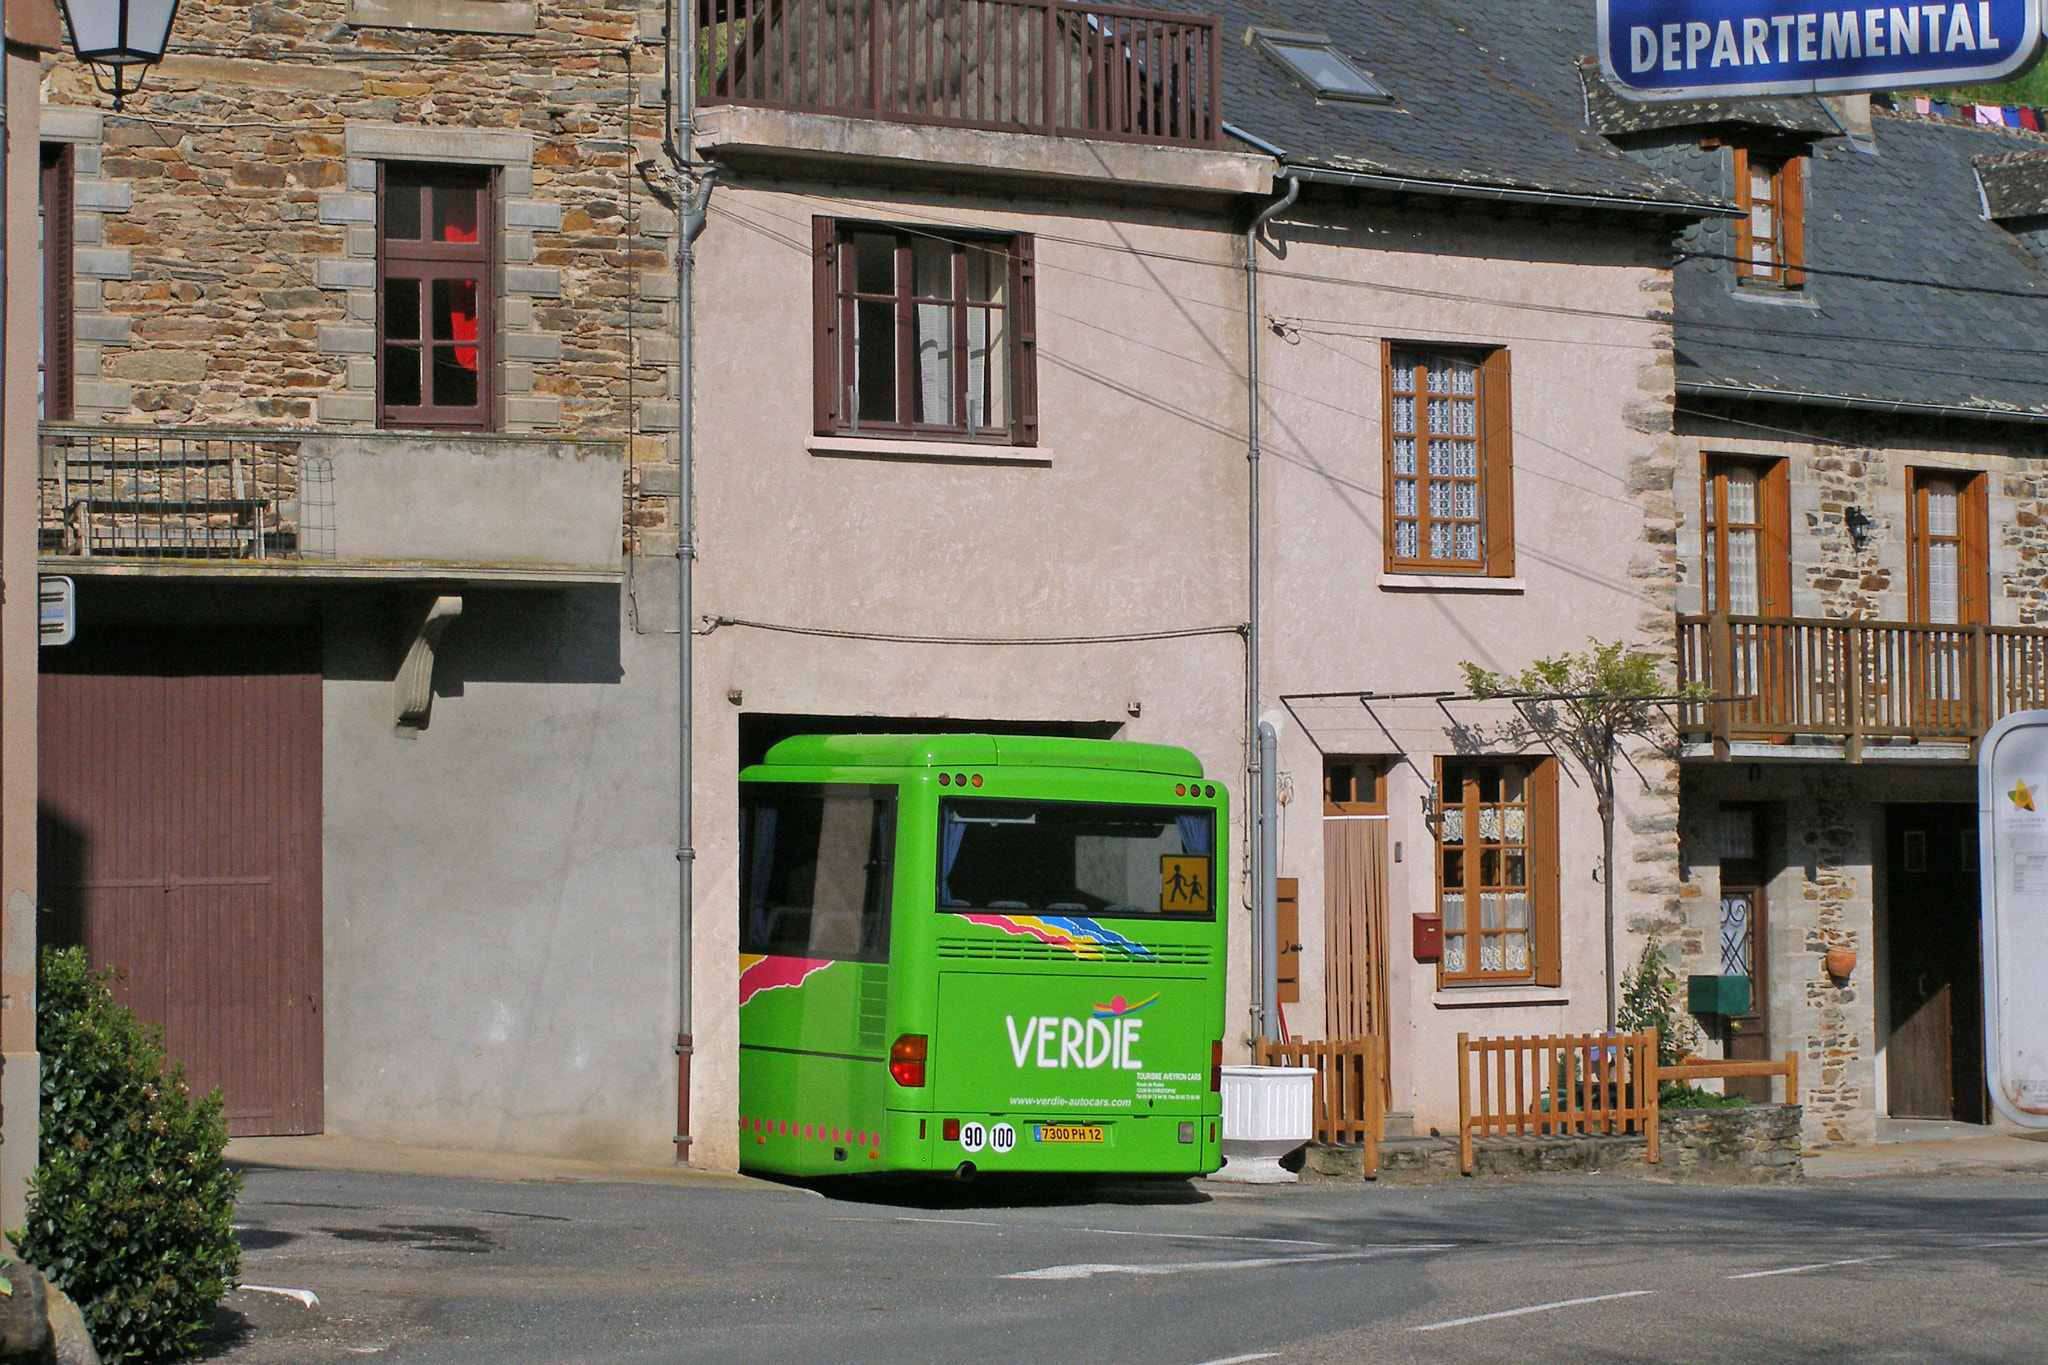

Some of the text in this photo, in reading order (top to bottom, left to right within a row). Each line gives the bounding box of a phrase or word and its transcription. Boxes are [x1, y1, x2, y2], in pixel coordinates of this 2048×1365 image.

[1630, 1, 2000, 74] DEPARTEMENTAL
[1006, 1015, 1144, 1069] VERDIE
[1136, 1072, 1202, 1081] TOURISME AVEYRON CARS
[965, 1127, 982, 1147] 90
[992, 1128, 1013, 1147] 100
[1042, 1128, 1102, 1140] 7300 PH 12
